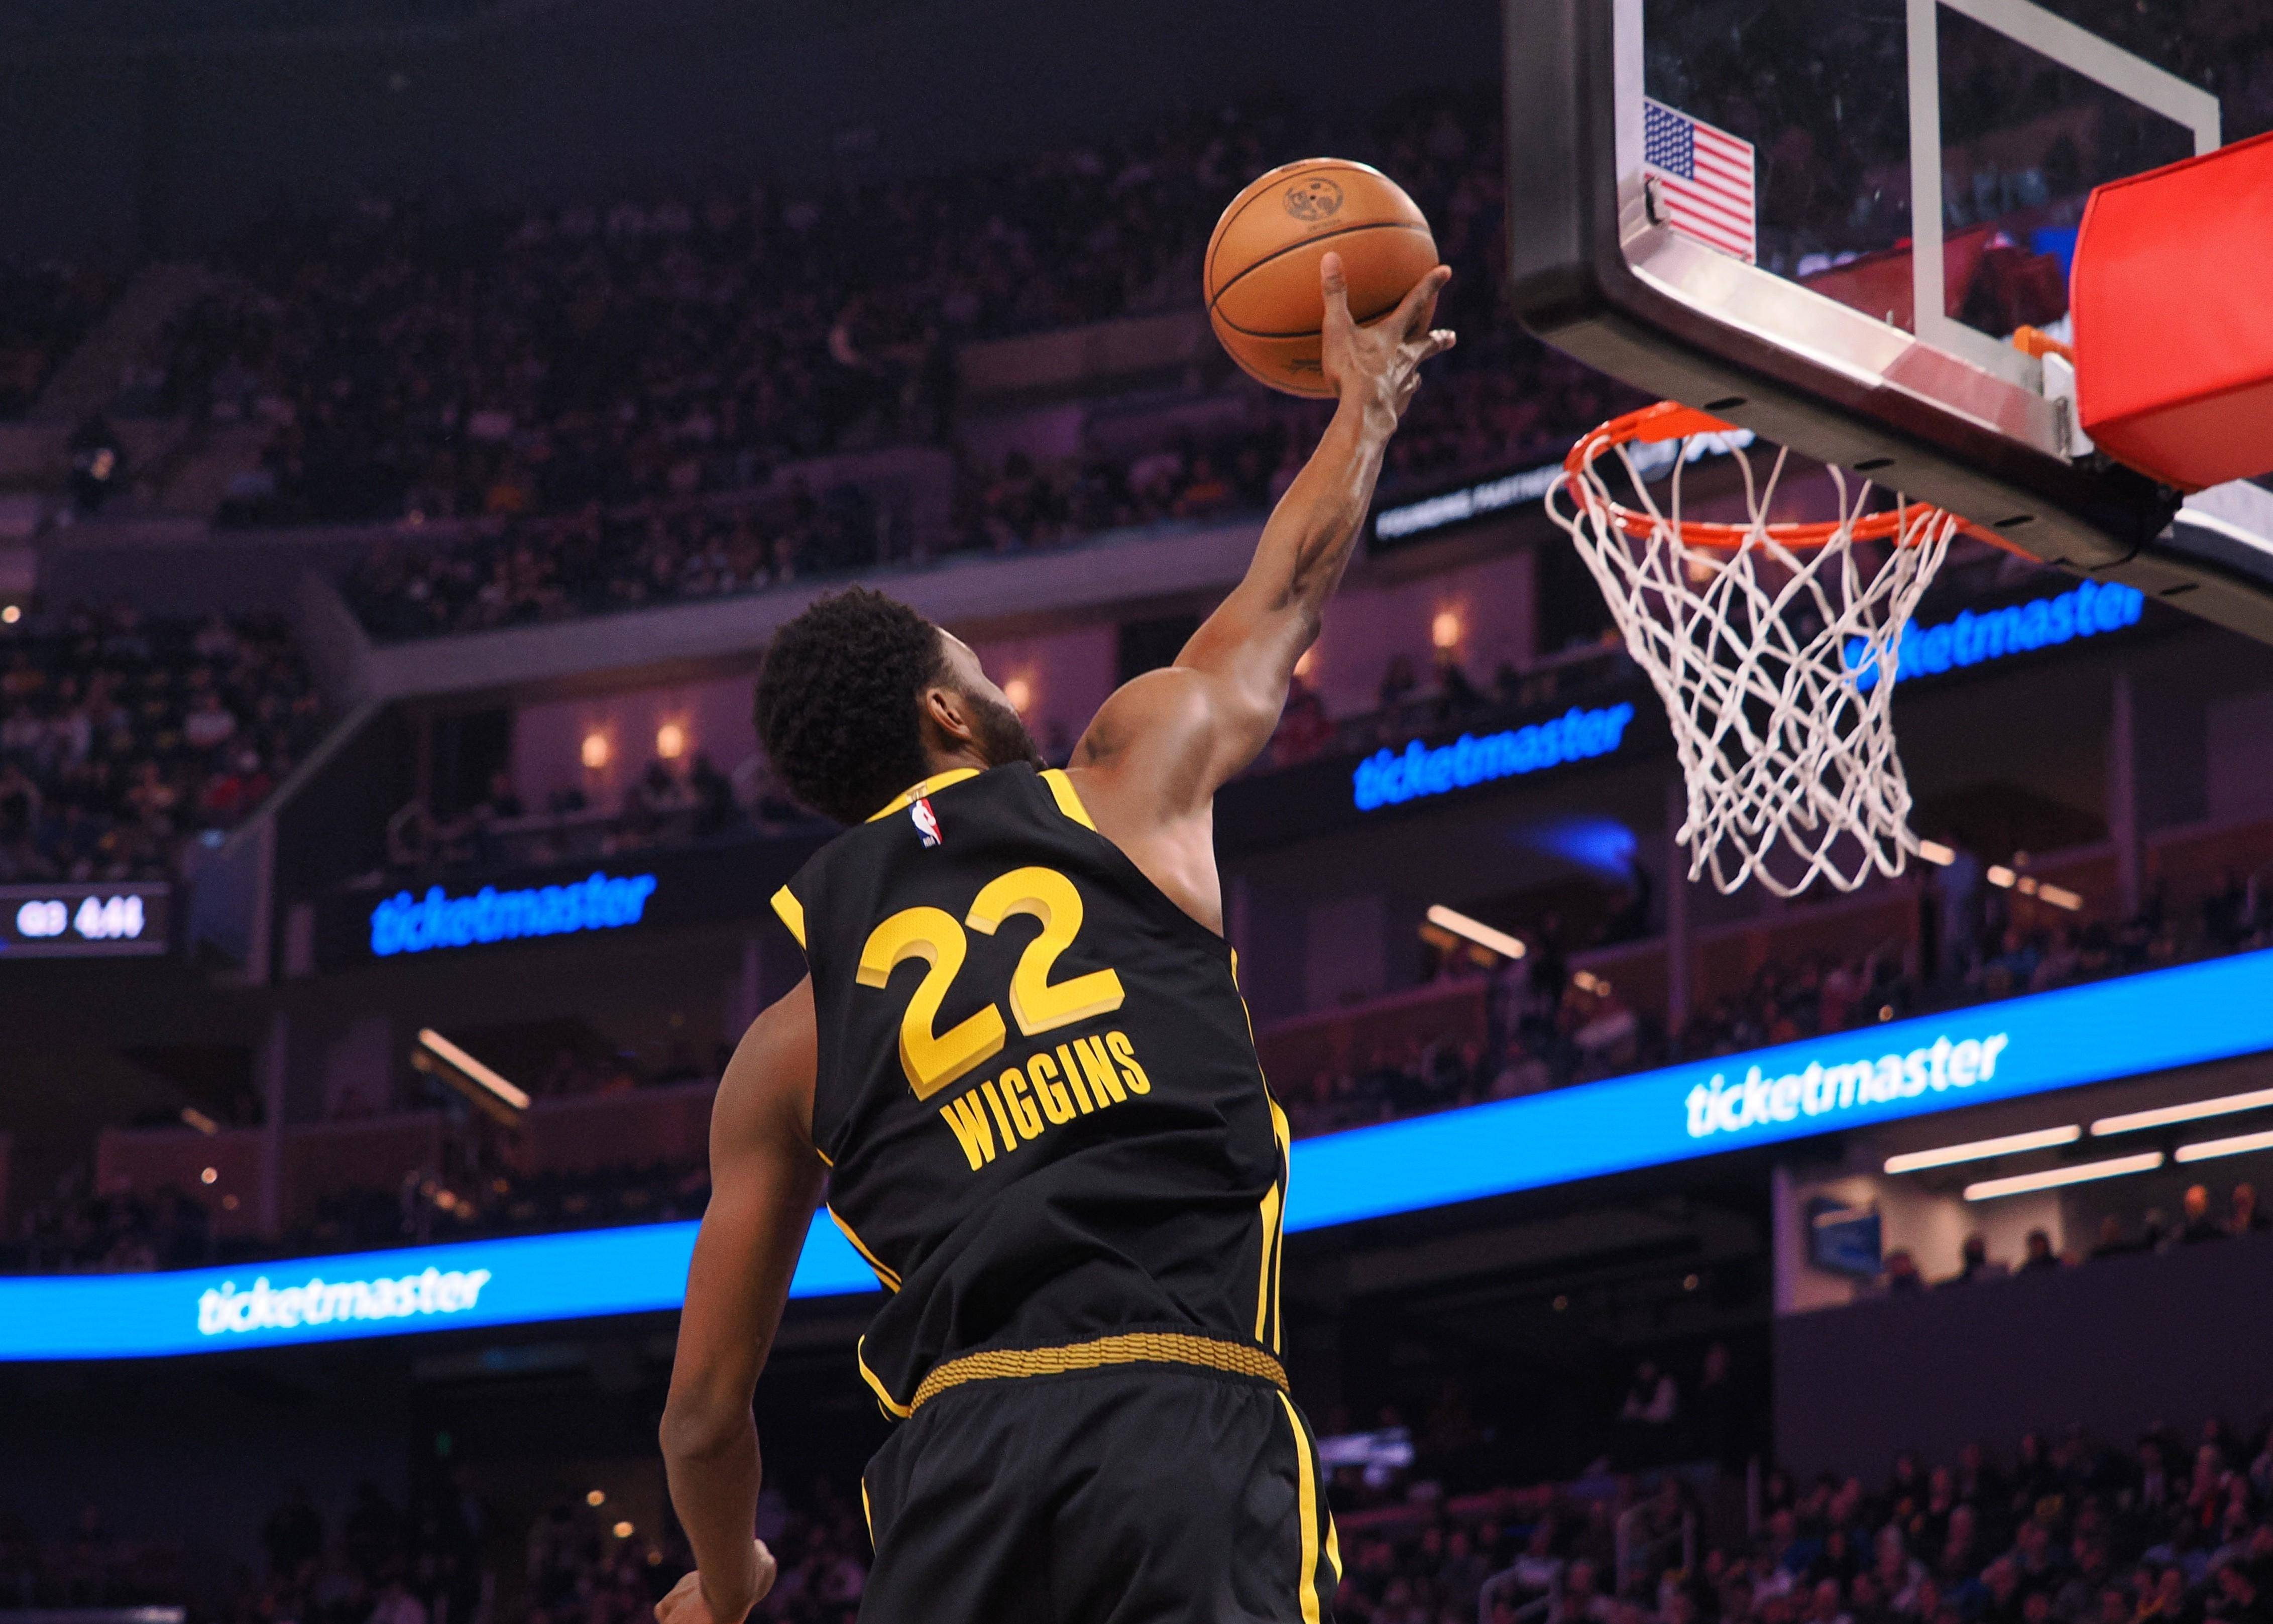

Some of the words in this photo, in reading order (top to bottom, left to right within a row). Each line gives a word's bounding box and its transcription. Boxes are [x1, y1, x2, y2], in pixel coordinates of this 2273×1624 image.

[1352, 702, 1635, 811] ticketmaster
[370, 871, 657, 957] ticketmaster
[855, 865, 1125, 1102] 22
[939, 1030, 1151, 1172] WIGGINS
[1685, 1032, 2008, 1138] ticketmaster
[198, 1267, 491, 1335] ticketmaster
